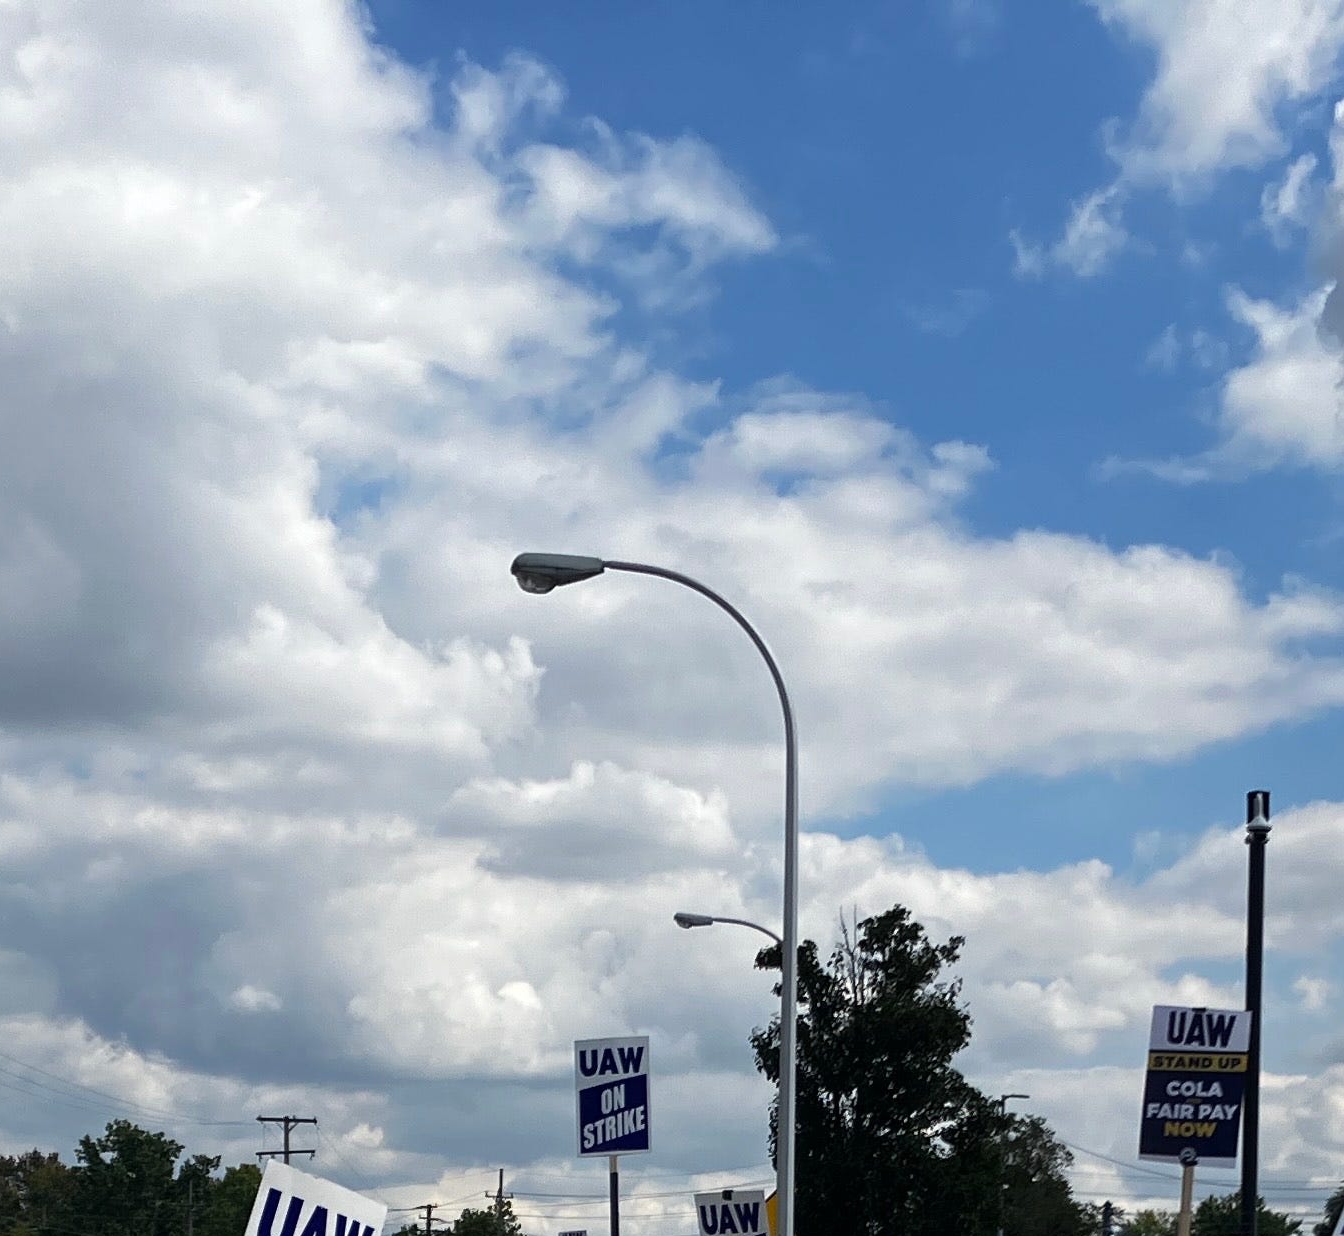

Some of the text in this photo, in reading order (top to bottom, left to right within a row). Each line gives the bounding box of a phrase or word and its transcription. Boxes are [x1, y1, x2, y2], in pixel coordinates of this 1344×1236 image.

[1167, 1010, 1236, 1048] UAW
[579, 1046, 644, 1077] UAW
[1152, 1056, 1241, 1069] STAND UP
[601, 1084, 625, 1115] ON
[1166, 1080, 1223, 1098] COLA
[1146, 1102, 1239, 1120] FAIR PAY
[583, 1105, 646, 1150] STRIKE
[1163, 1121, 1218, 1138] NOW
[699, 1201, 760, 1236] UAW
